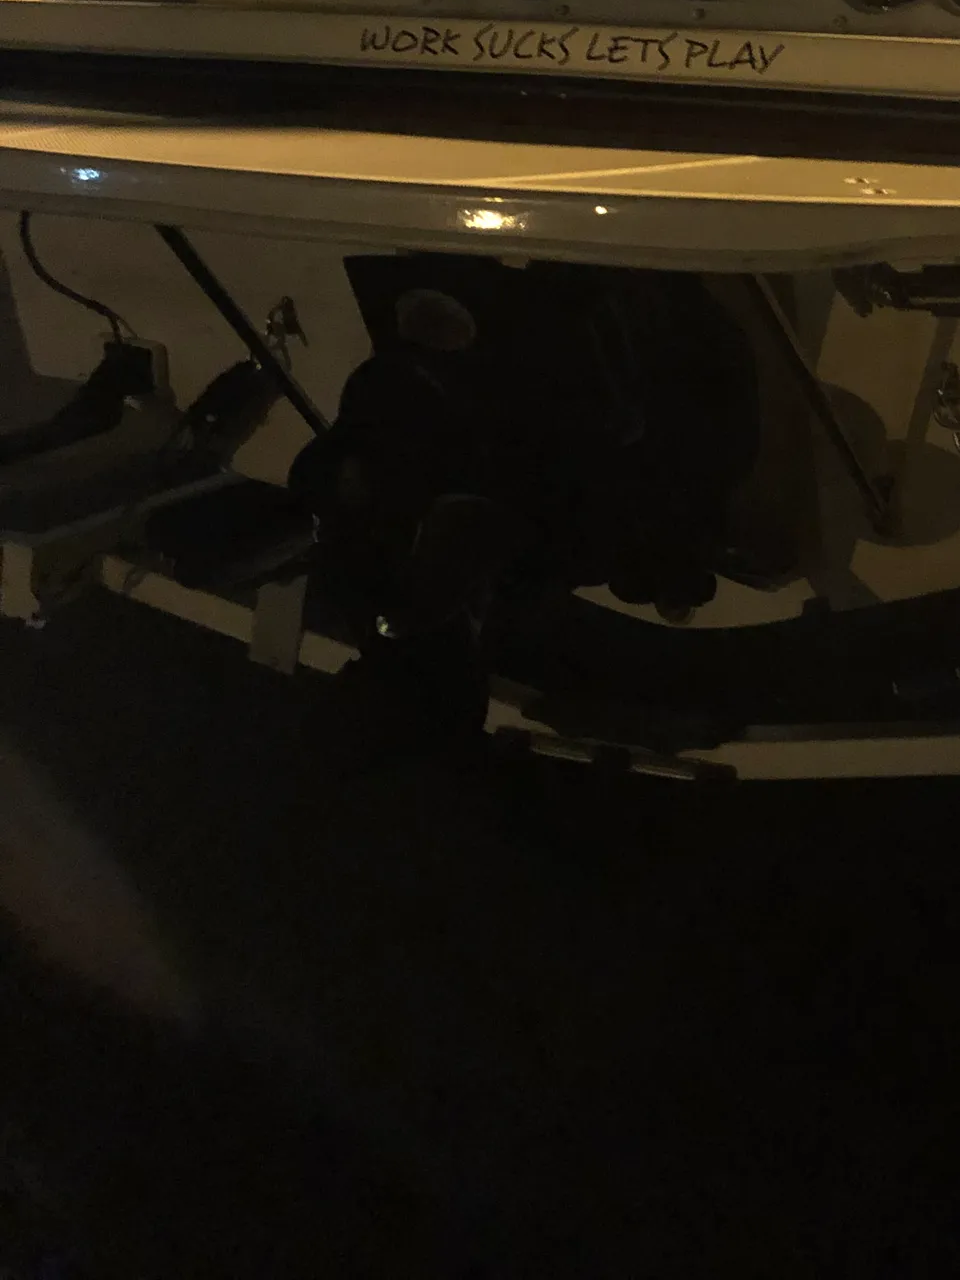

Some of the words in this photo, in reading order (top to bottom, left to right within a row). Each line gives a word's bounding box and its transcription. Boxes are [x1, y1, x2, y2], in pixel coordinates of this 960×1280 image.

[360, 25, 461, 55] WORK
[472, 23, 579, 65] SUCKS
[586, 32, 678, 71] LETS
[684, 38, 785, 73] PLAY
